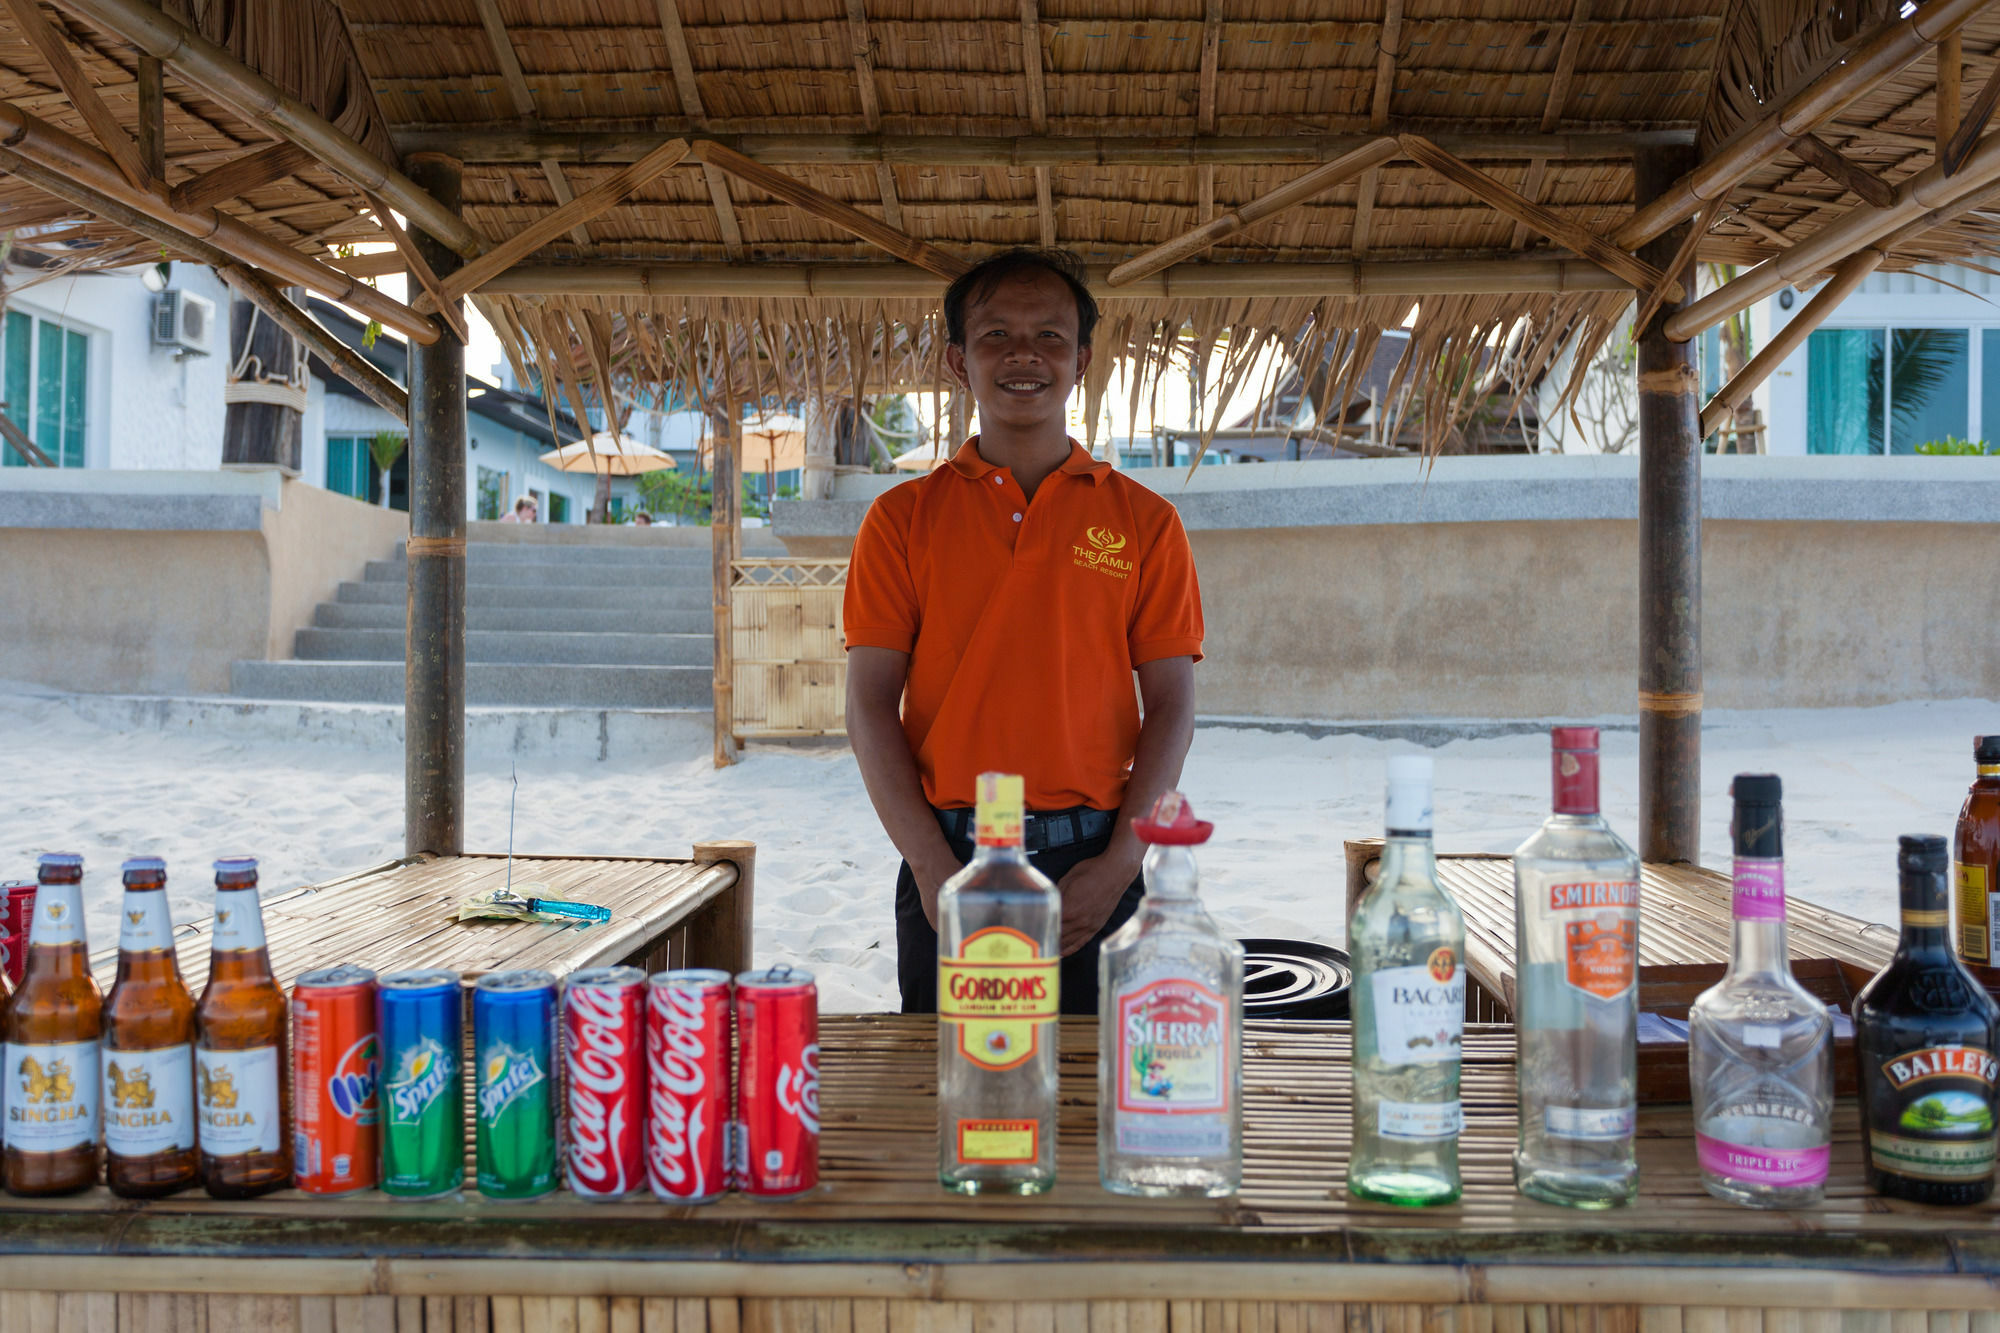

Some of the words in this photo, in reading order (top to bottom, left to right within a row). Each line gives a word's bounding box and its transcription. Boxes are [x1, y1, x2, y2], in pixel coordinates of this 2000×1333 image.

[1073, 558, 1098, 572] BEACH
[1100, 566, 1128, 580] RESORT
[1127, 1013, 1221, 1049] SIERRA
[1890, 1050, 1998, 1083] BAILEYS
[395, 1056, 452, 1121] Sprite
[479, 1060, 532, 1119] Sprite
[9, 1102, 89, 1123] SINGHA
[1727, 1152, 1772, 1169] TRIPLE
[1777, 1159, 1801, 1169] SEC
